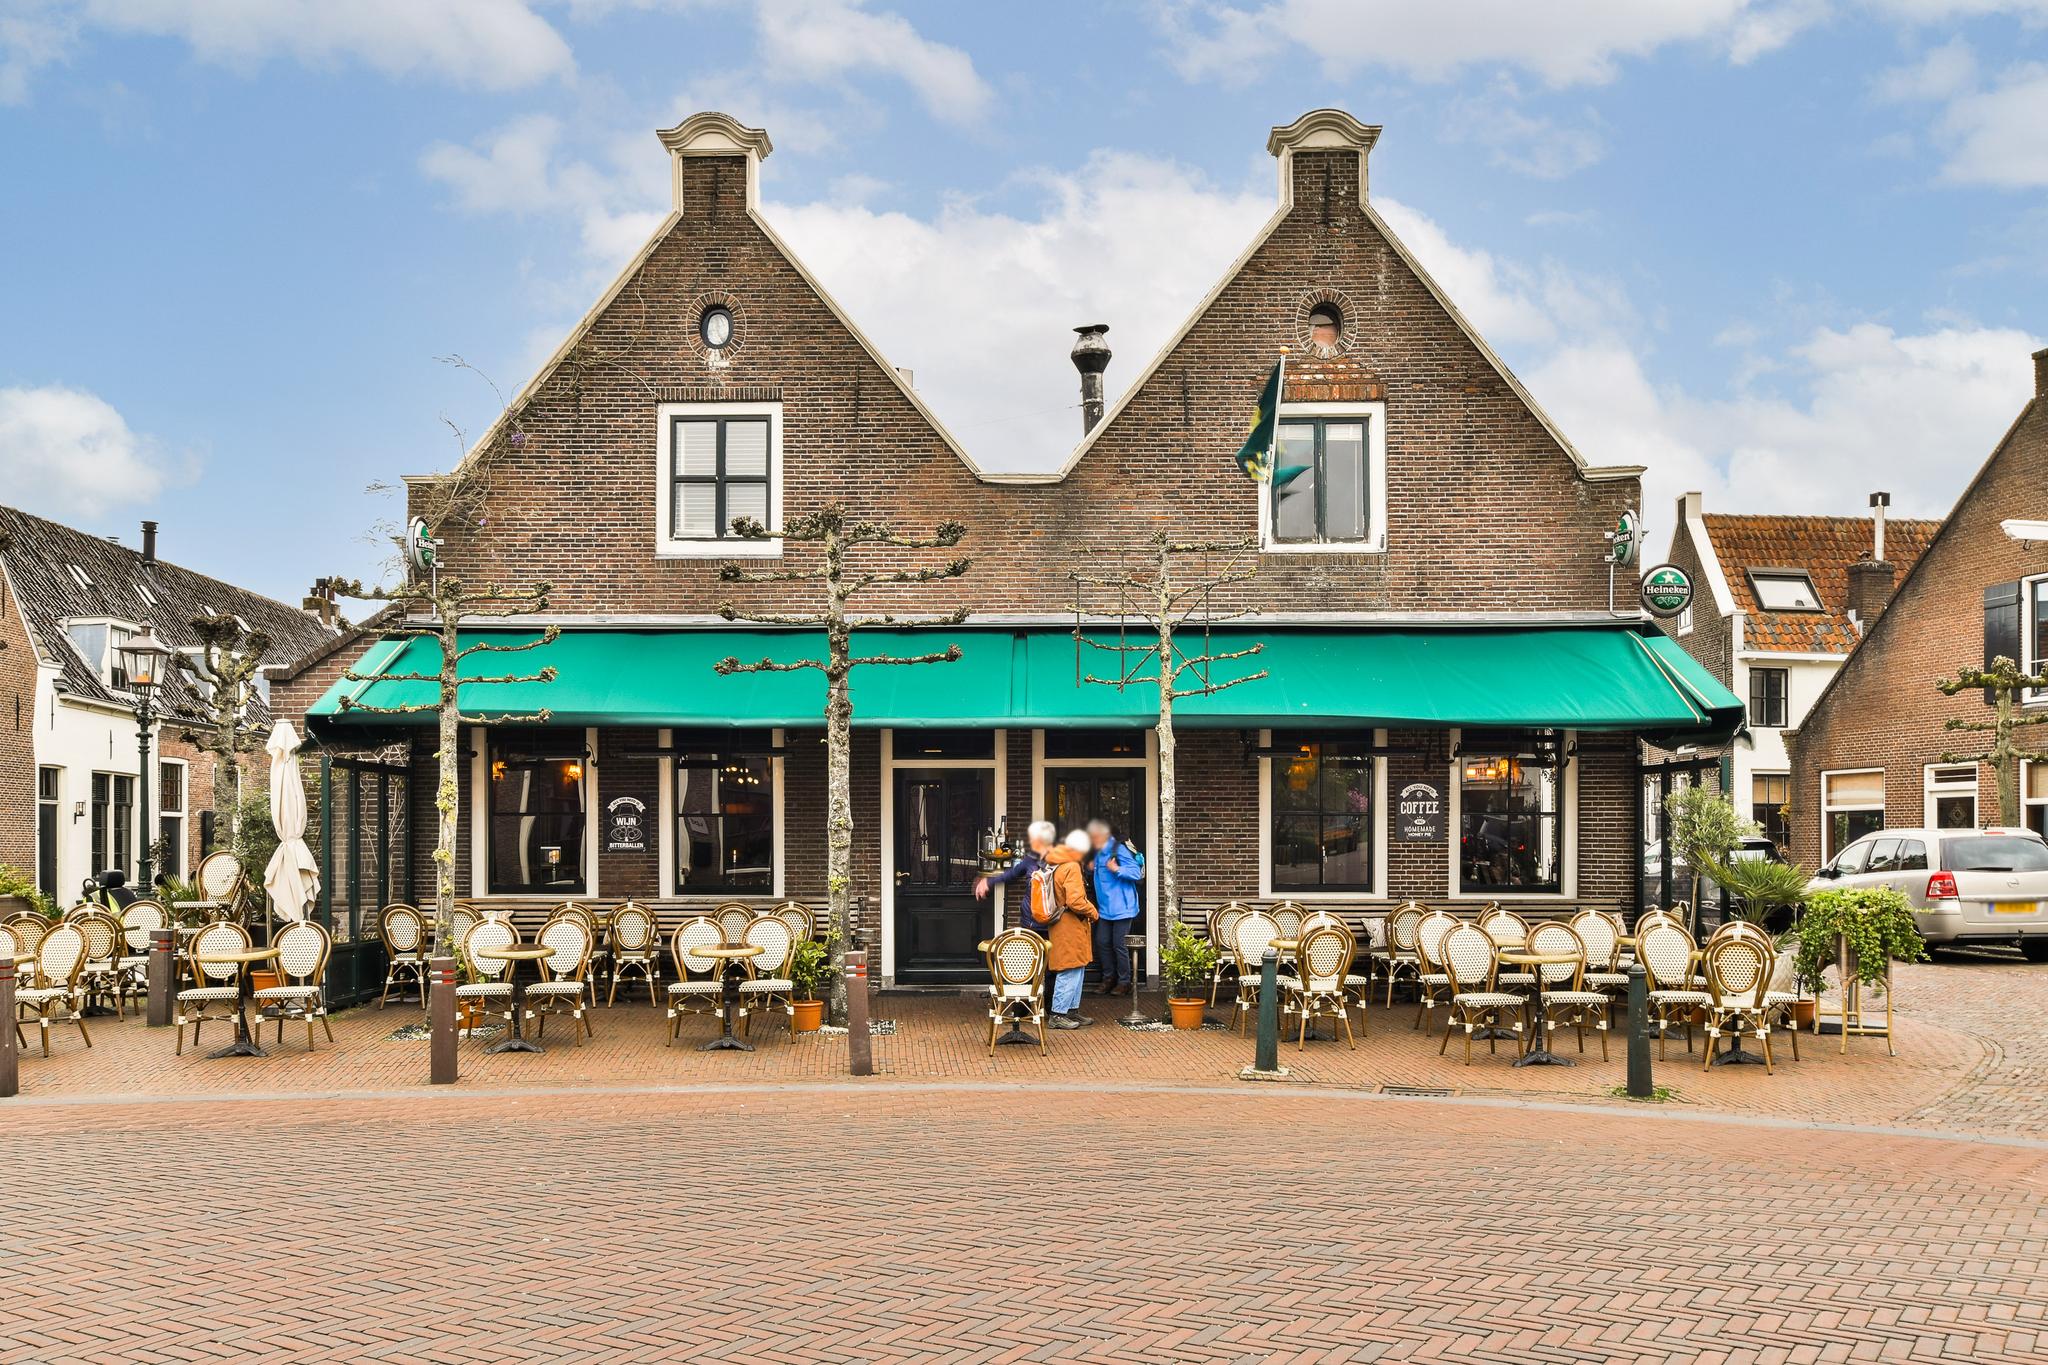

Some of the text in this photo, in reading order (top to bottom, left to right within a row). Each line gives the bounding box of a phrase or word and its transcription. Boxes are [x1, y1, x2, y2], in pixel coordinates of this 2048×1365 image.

[1646, 586, 1688, 594] Heineken
[1400, 801, 1439, 814] COFFEE
[616, 817, 637, 826] WIJN
